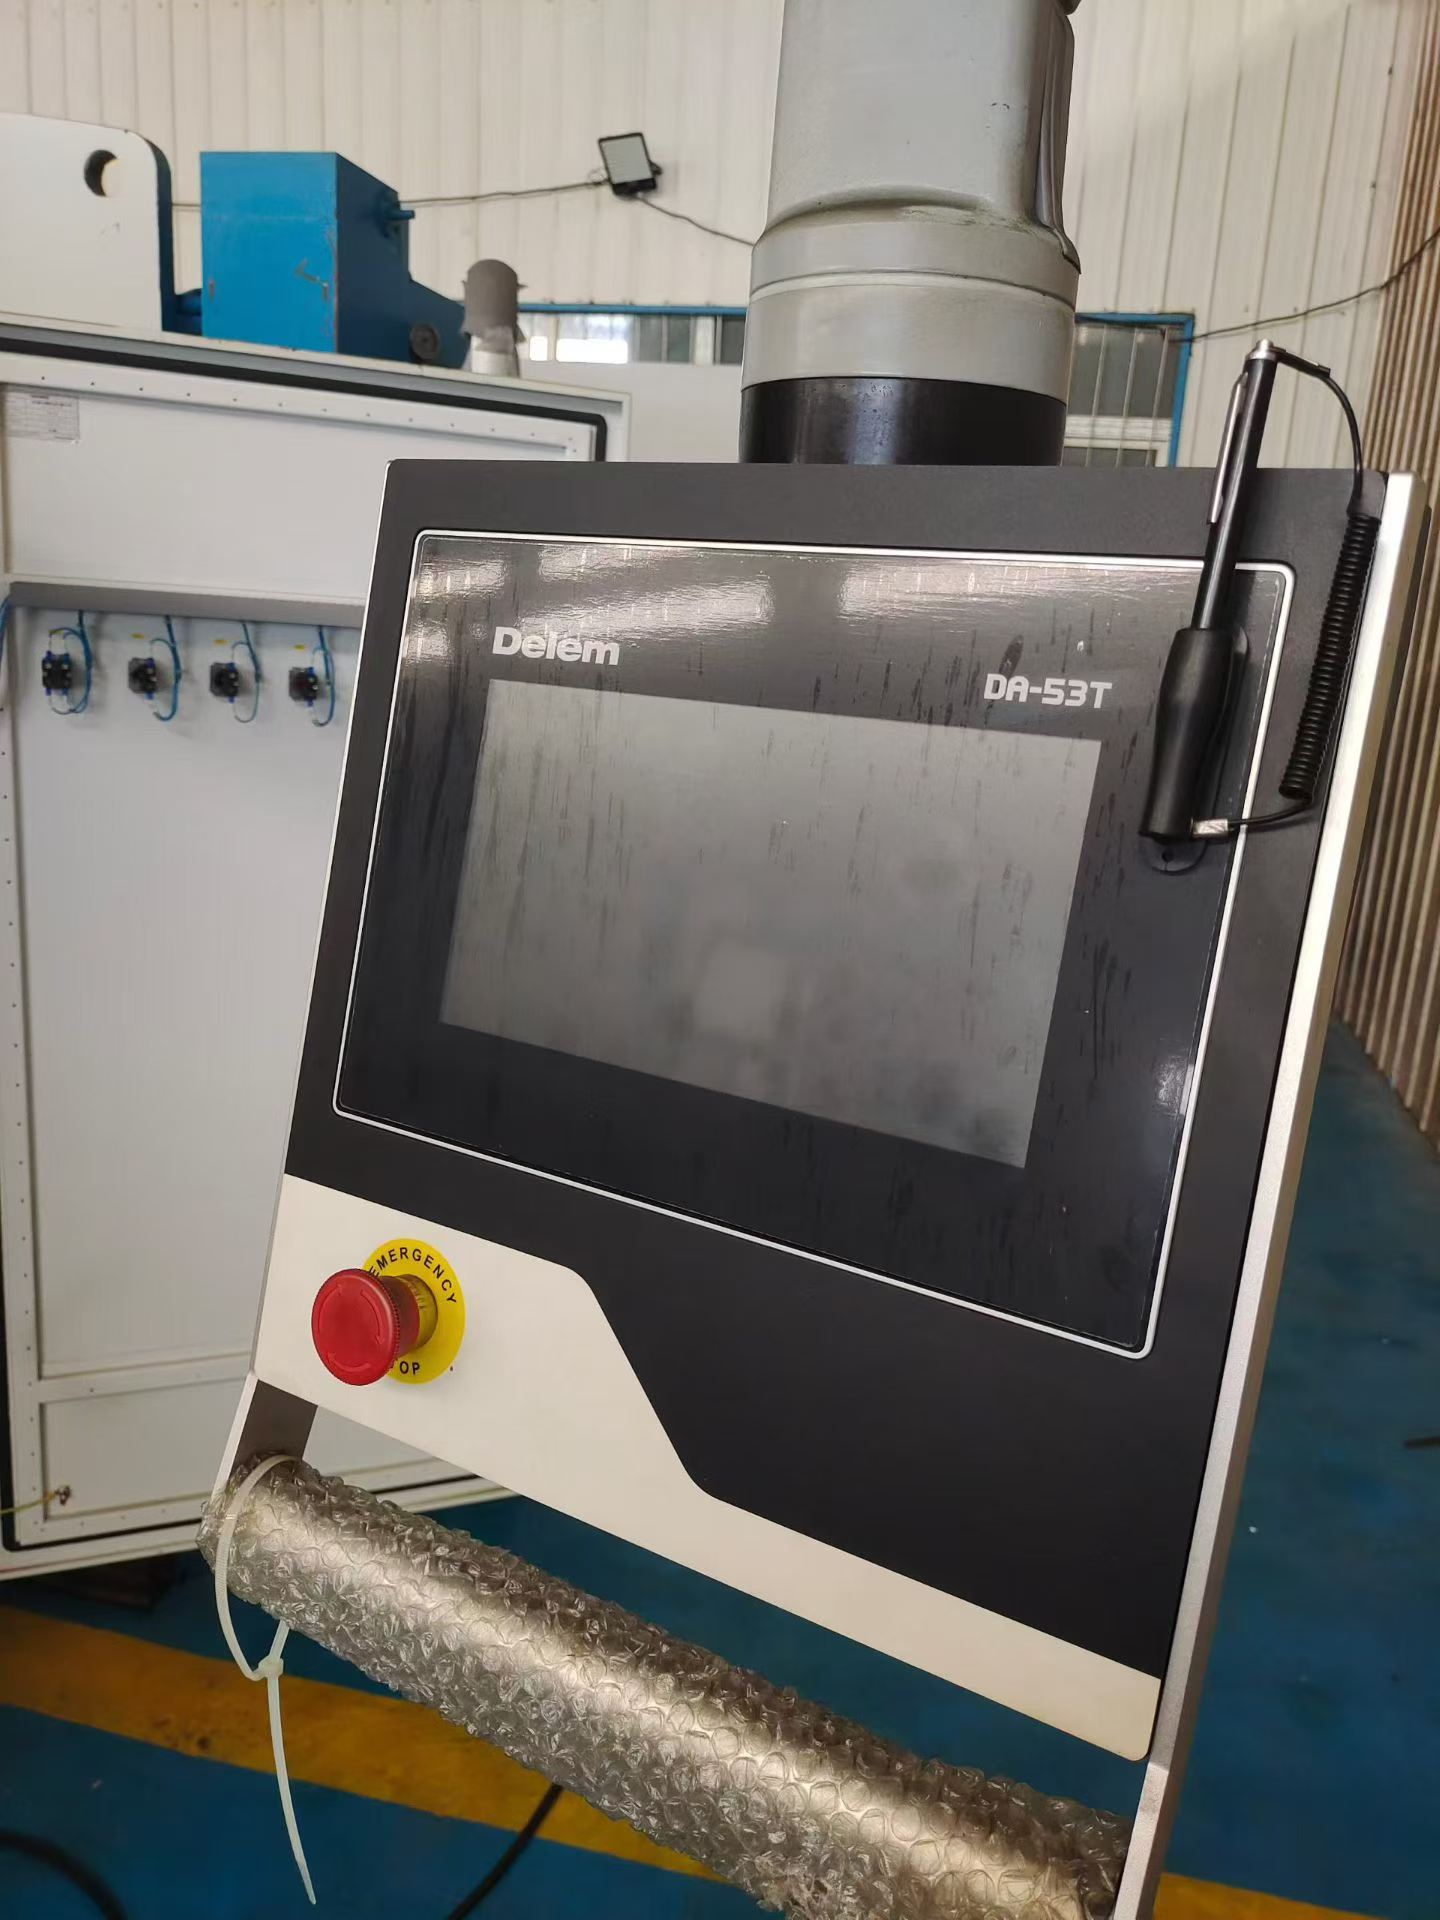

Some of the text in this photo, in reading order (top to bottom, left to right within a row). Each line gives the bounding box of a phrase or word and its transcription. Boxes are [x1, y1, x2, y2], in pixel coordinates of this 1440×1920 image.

[492, 626, 620, 666] Delem
[983, 673, 1113, 709] DA-53T
[368, 1246, 457, 1304] EMERGENCY
[399, 1360, 421, 1376] OP
